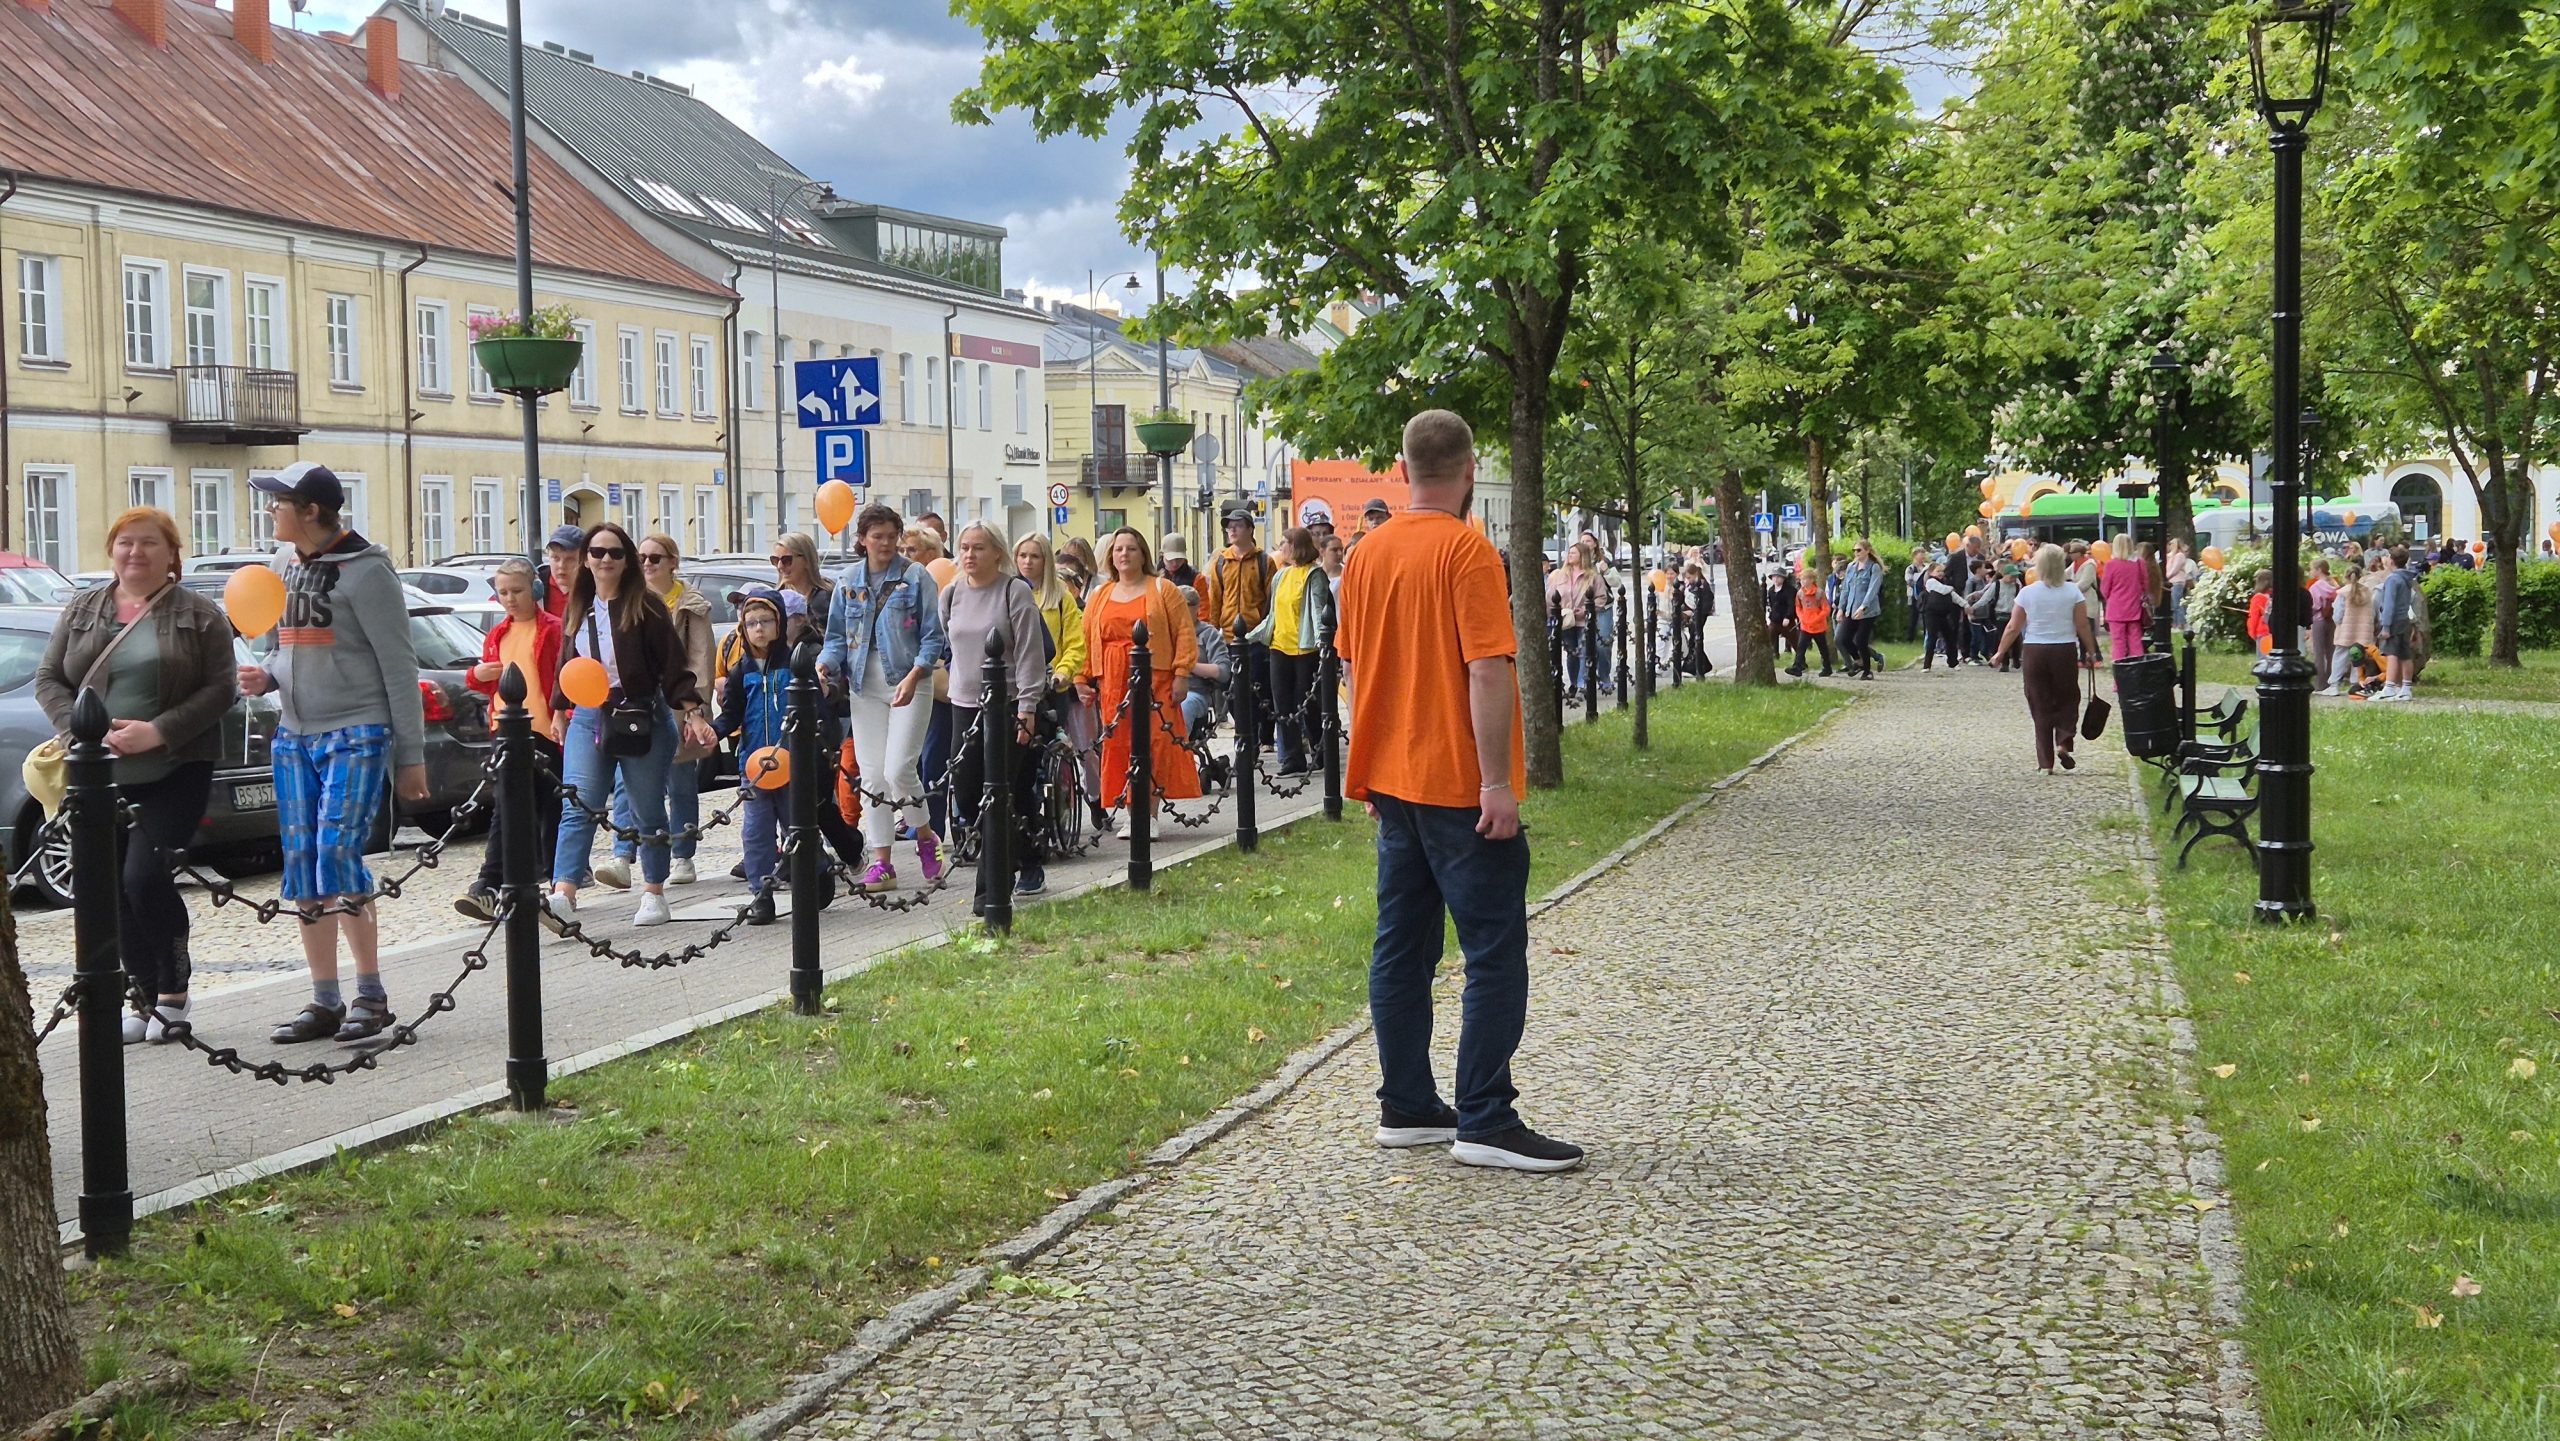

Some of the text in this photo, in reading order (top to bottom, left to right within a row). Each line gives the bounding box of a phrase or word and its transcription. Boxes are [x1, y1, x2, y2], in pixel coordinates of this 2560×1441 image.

[826, 435, 853, 479] P
[1053, 488, 1066, 500] 40
[1786, 506, 1796, 518] P
[279, 592, 333, 628] IDS
[238, 784, 273, 806] BS 357
